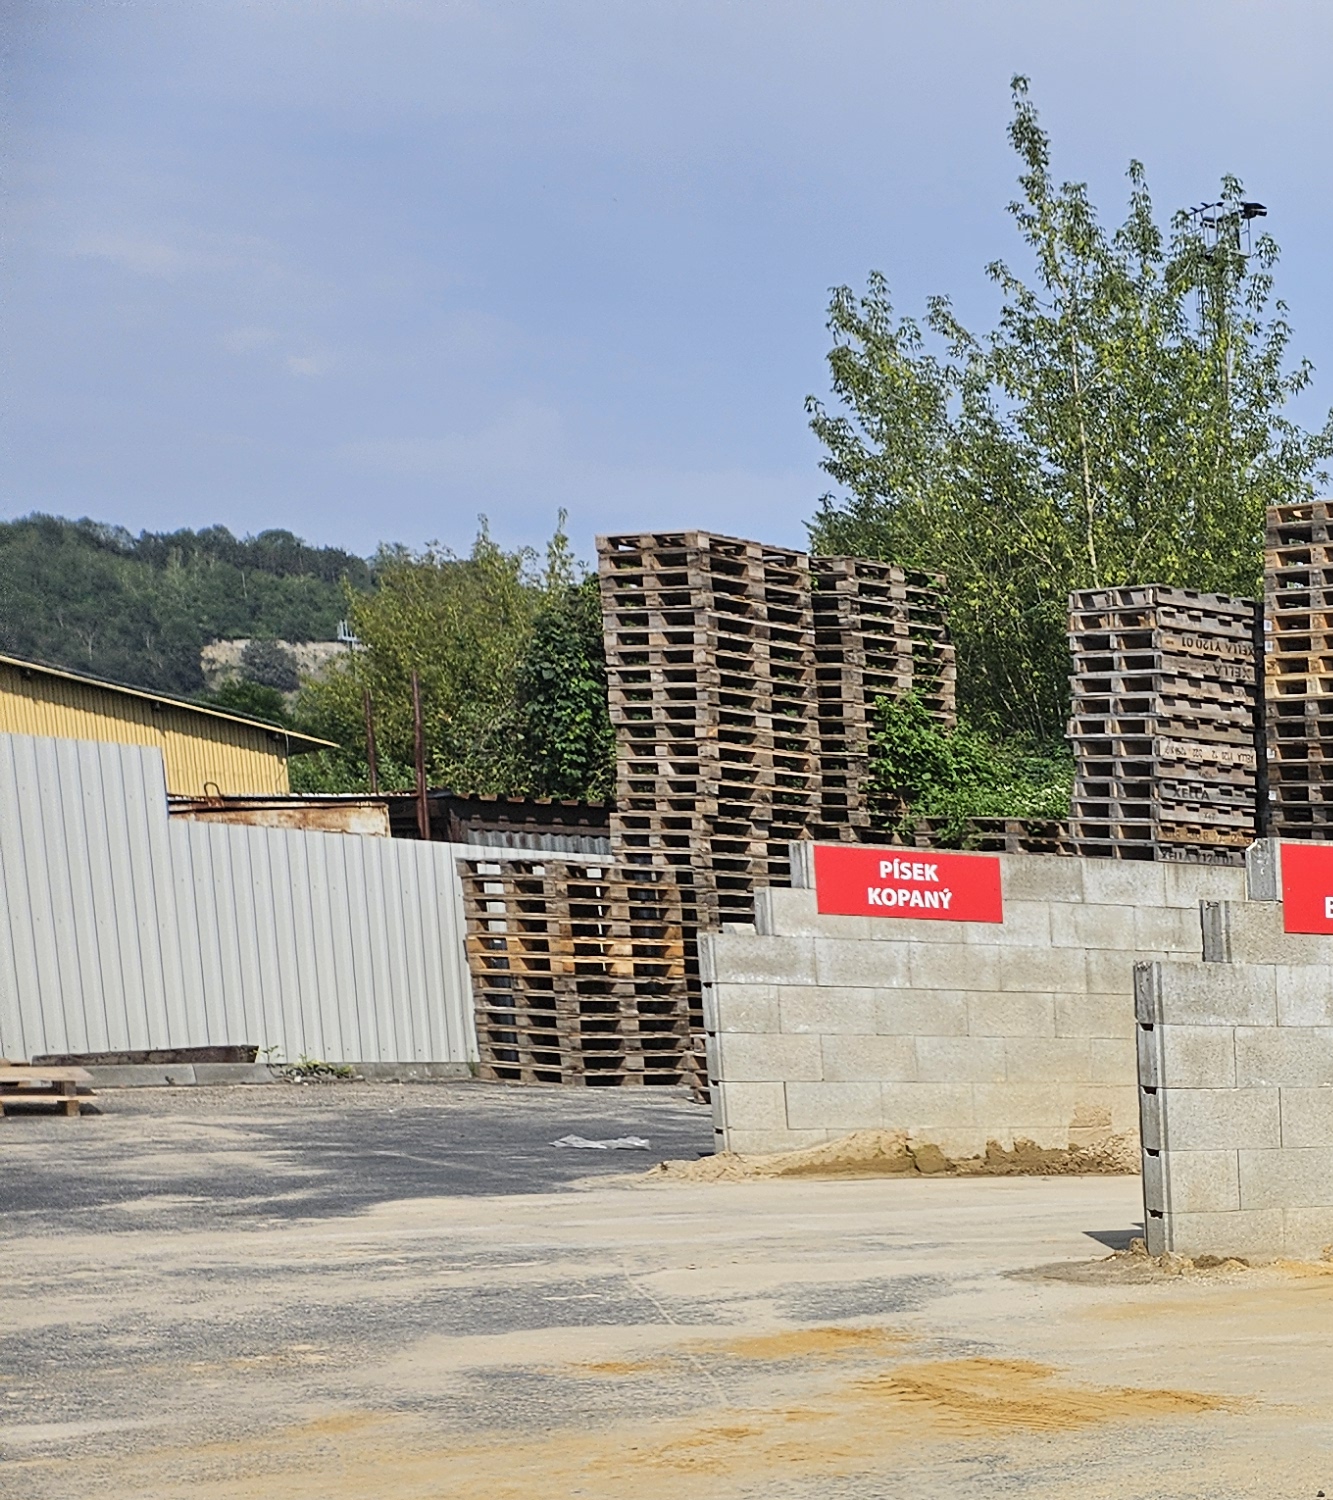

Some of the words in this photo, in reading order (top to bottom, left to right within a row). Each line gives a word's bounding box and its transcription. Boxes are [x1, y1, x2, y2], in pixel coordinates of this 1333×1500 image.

[1212, 663, 1251, 679] XELLA
[879, 858, 939, 882] PÍSEK
[867, 887, 953, 910] KOPANÝ
